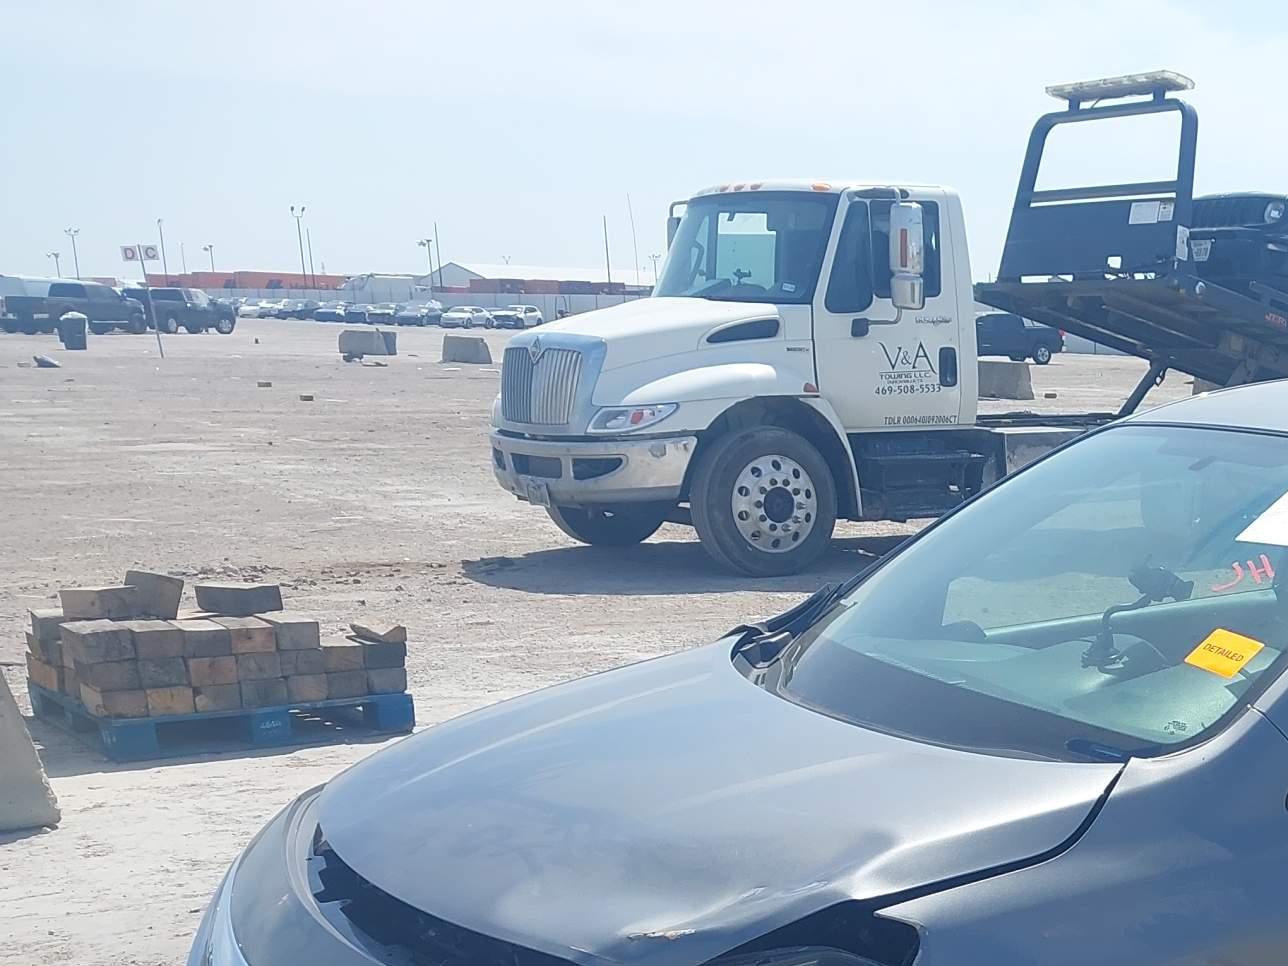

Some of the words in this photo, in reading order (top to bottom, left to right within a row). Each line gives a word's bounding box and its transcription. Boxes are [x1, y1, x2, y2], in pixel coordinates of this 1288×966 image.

[123, 247, 135, 260] D
[144, 246, 156, 259] C
[878, 341, 937, 375] V&A
[880, 372, 912, 380] TOWING
[875, 383, 942, 396] 469-508-5533
[884, 416, 901, 425] TDLR
[1202, 643, 1245, 662] DETAILED
